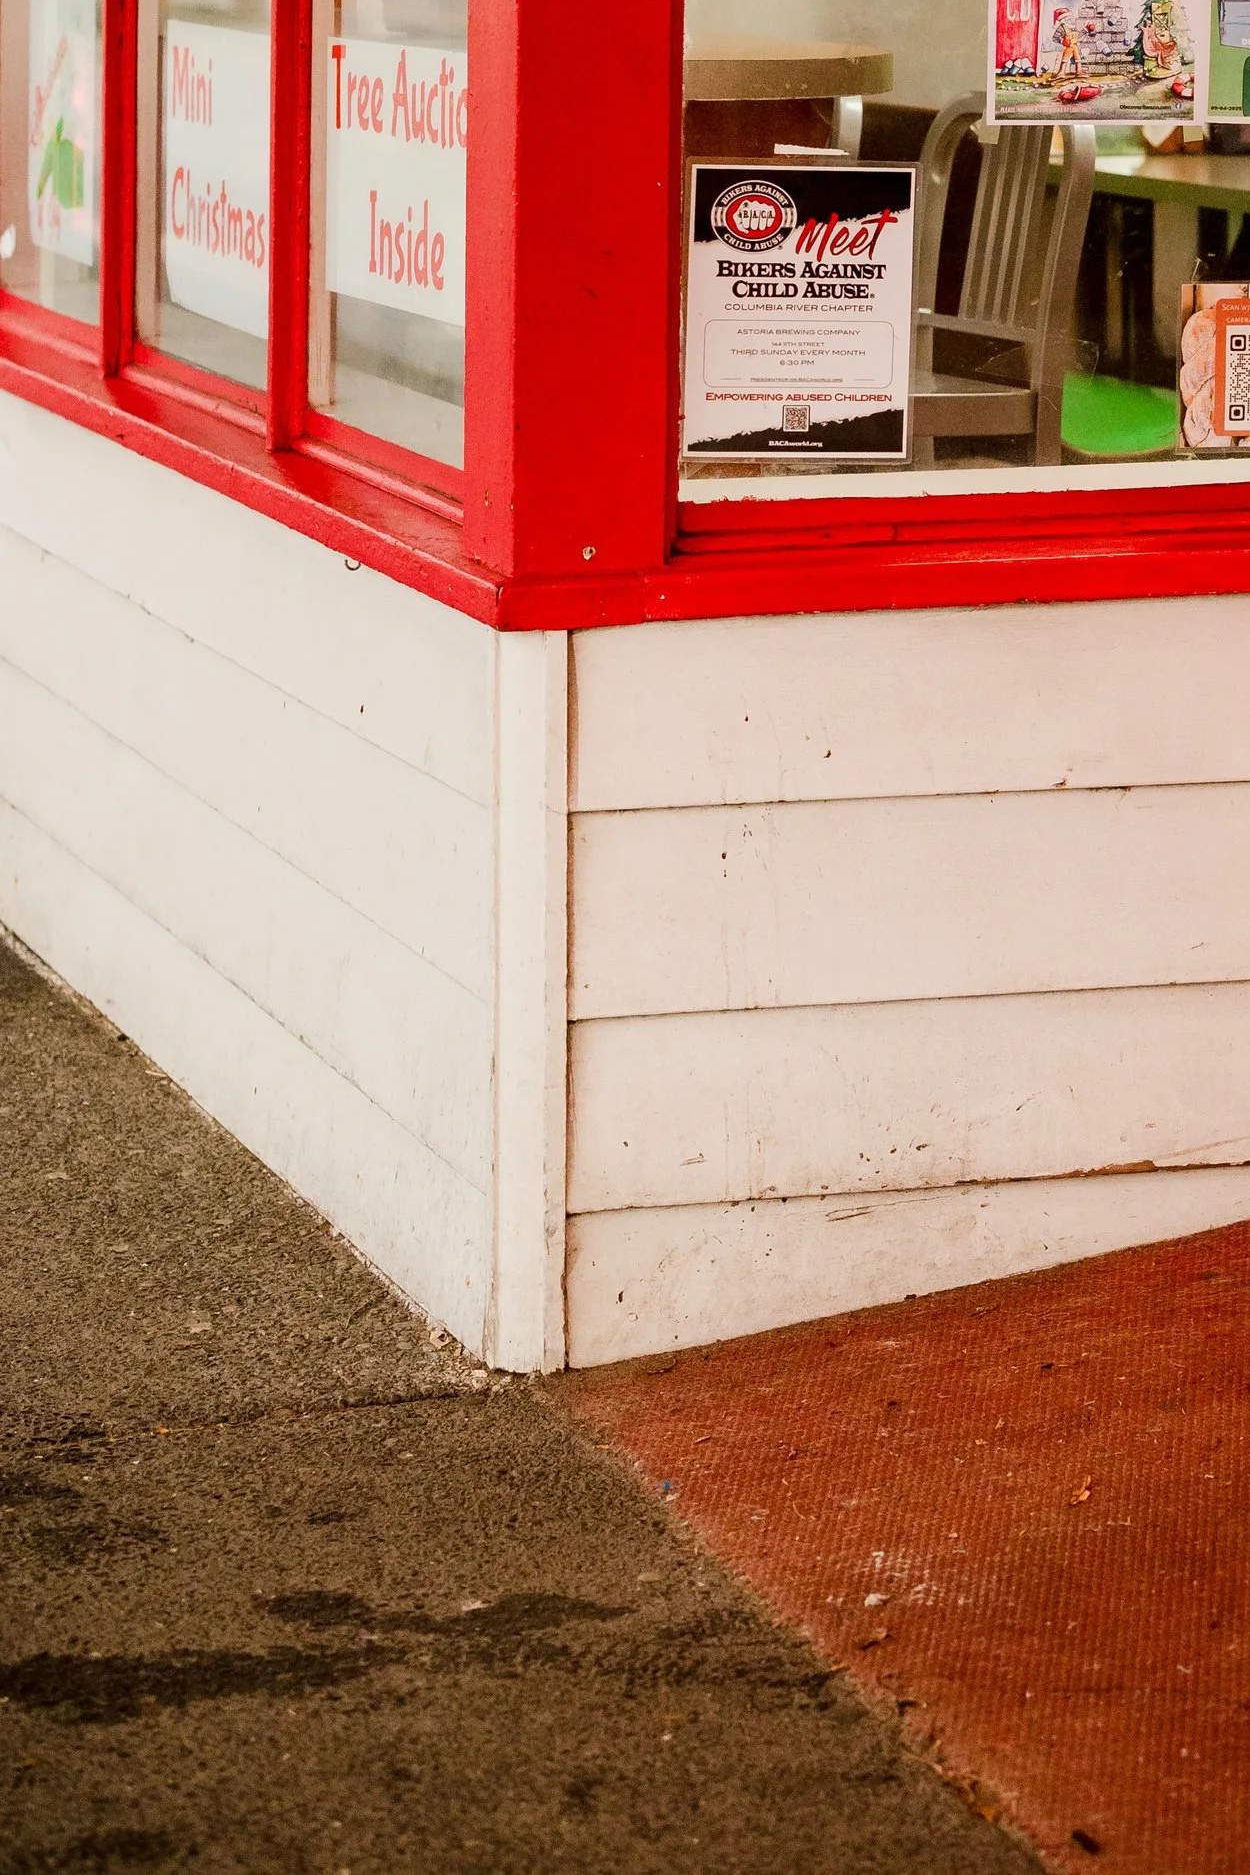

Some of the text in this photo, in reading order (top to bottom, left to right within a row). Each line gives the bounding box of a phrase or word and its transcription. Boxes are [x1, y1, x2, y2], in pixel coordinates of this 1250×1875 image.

[171, 44, 214, 127] Mini
[331, 44, 468, 150] Tree Auctio
[720, 185, 789, 206] BIKERS AGAINST
[170, 165, 266, 270] Christmas
[369, 189, 445, 292] Inside
[724, 233, 784, 250] CHILD ABUSE
[795, 208, 899, 262] Meet
[716, 260, 887, 280] BIKERS AGAINST
[732, 280, 799, 298] CHILD
[724, 303, 873, 312] COLUMBIA RIVER CHAPTER
[1222, 303, 1240, 311] SCAN
[705, 392, 893, 402] EMPOWERING ABUSED CHILDREN
[768, 440, 824, 448] BACAworld.org
